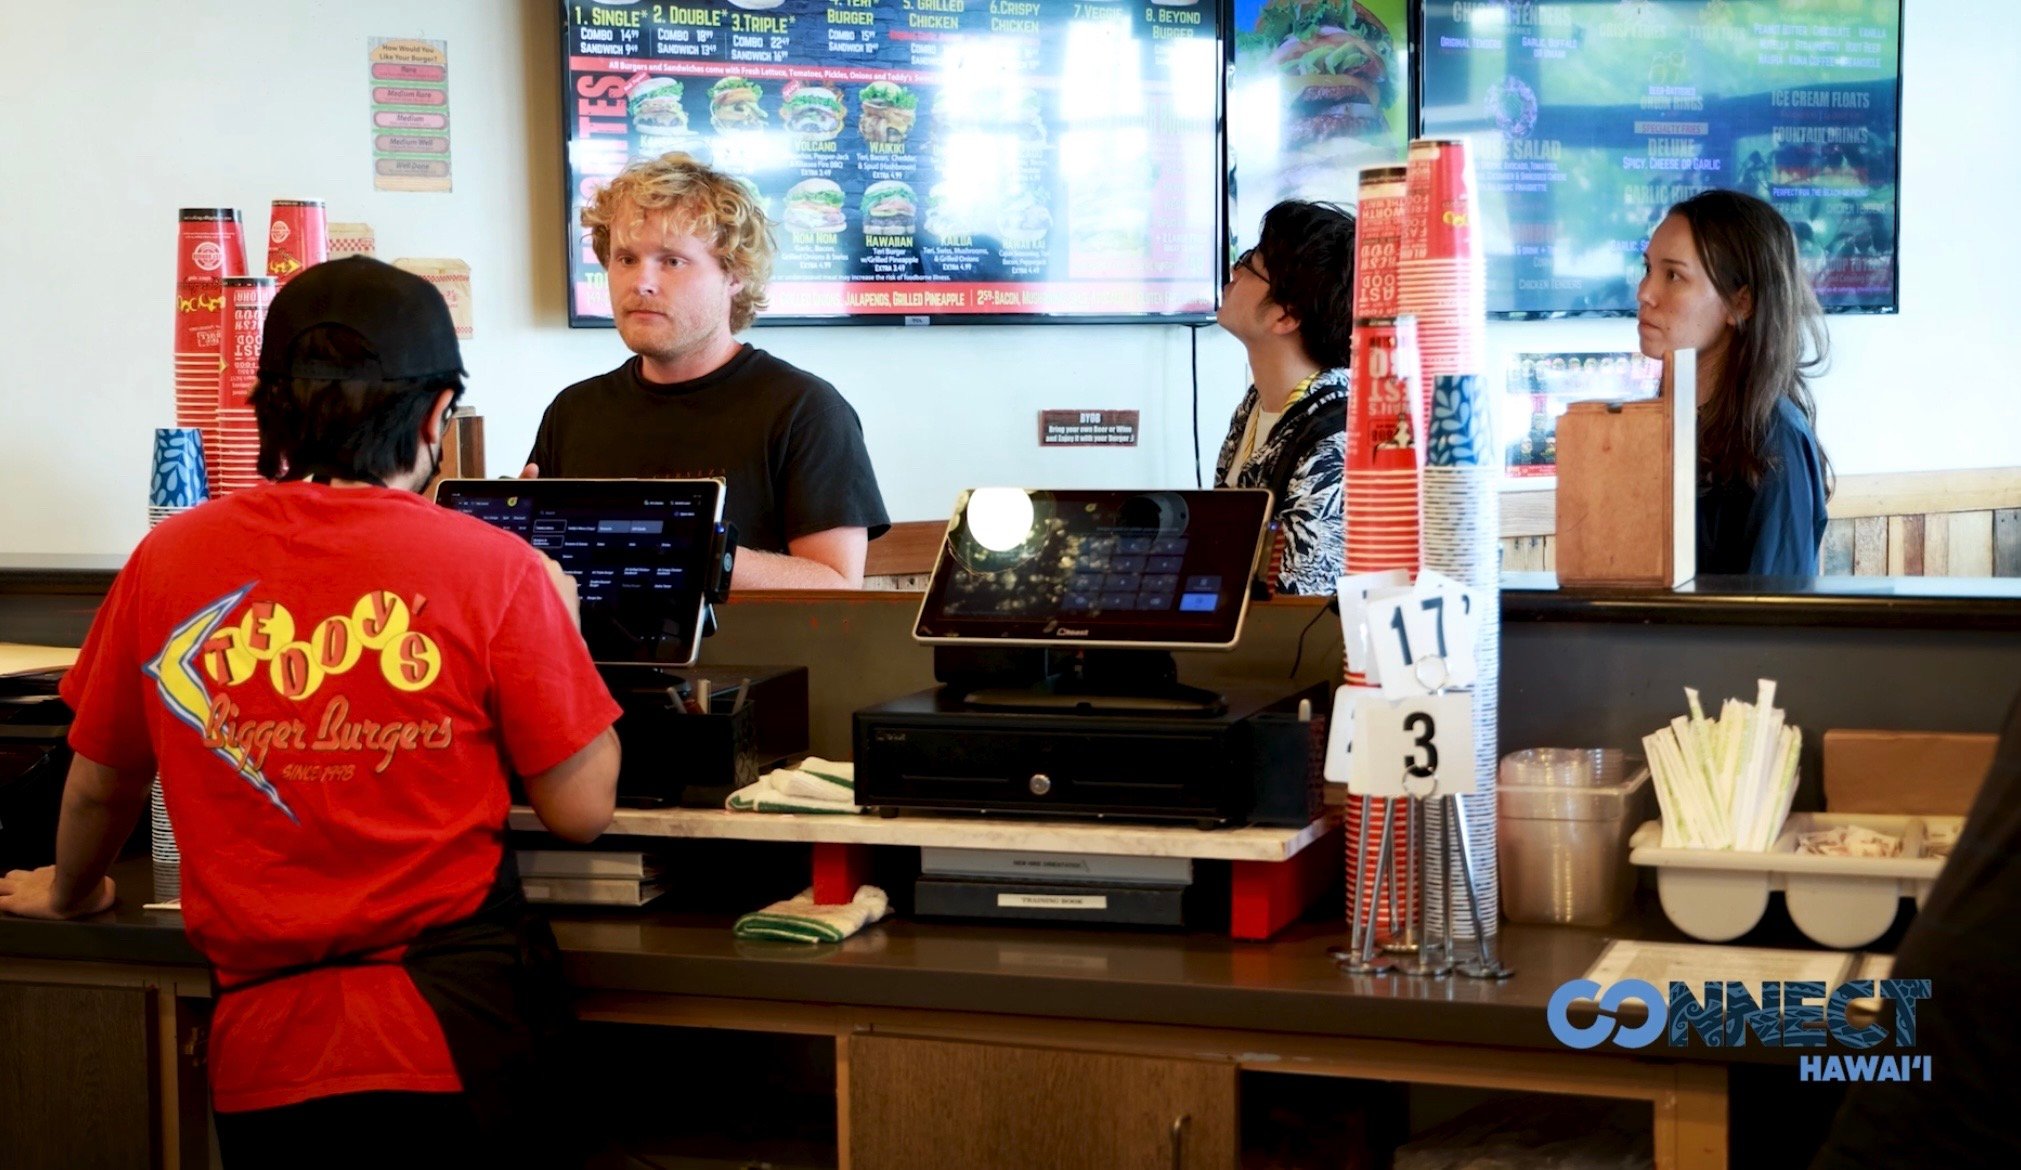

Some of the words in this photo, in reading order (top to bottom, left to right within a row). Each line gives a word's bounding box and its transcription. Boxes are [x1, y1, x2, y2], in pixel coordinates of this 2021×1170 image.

[917, 0, 965, 12] GRILLED
[827, 9, 874, 25] BURGER
[909, 13, 958, 29] CHICKEN
[1159, 9, 1201, 24] BEYOND
[991, 17, 1039, 33] CHICKEN
[581, 27, 613, 42] COMBO
[657, 28, 689, 42] COMBO
[732, 35, 764, 48] COMBO
[828, 29, 855, 41] COMBO
[580, 42, 623, 56] SANDWICH
[657, 43, 699, 56] SANDWICH
[828, 42, 864, 53] SANDWICH
[731, 49, 772, 62] SANDWICH
[1771, 90, 1790, 107] ICE
[1791, 90, 1830, 107] CREAM
[1831, 92, 1870, 109] FLOATS
[397, 114, 424, 122] Medium
[1827, 127, 1870, 144] DRINKS
[869, 142, 905, 154] WAIKIKI
[1513, 140, 1562, 160] SALAD
[1647, 139, 1696, 157] DELUXE
[1649, 157, 1680, 170] CHEESE
[1680, 158, 1692, 170] OR
[1692, 158, 1721, 170] GARLIC
[1773, 187, 1799, 197] PERFECT
[866, 235, 913, 247] HAWAIIAN
[1080, 413, 1101, 423] BYOB
[1048, 426, 1065, 434] Bring
[1066, 426, 1079, 434] your
[203, 590, 430, 697] TEDDY'S
[203, 693, 306, 771] Bigger
[312, 695, 452, 773] Burgers
[1403, 712, 1439, 778] 3
[282, 764, 320, 781] SINCE
